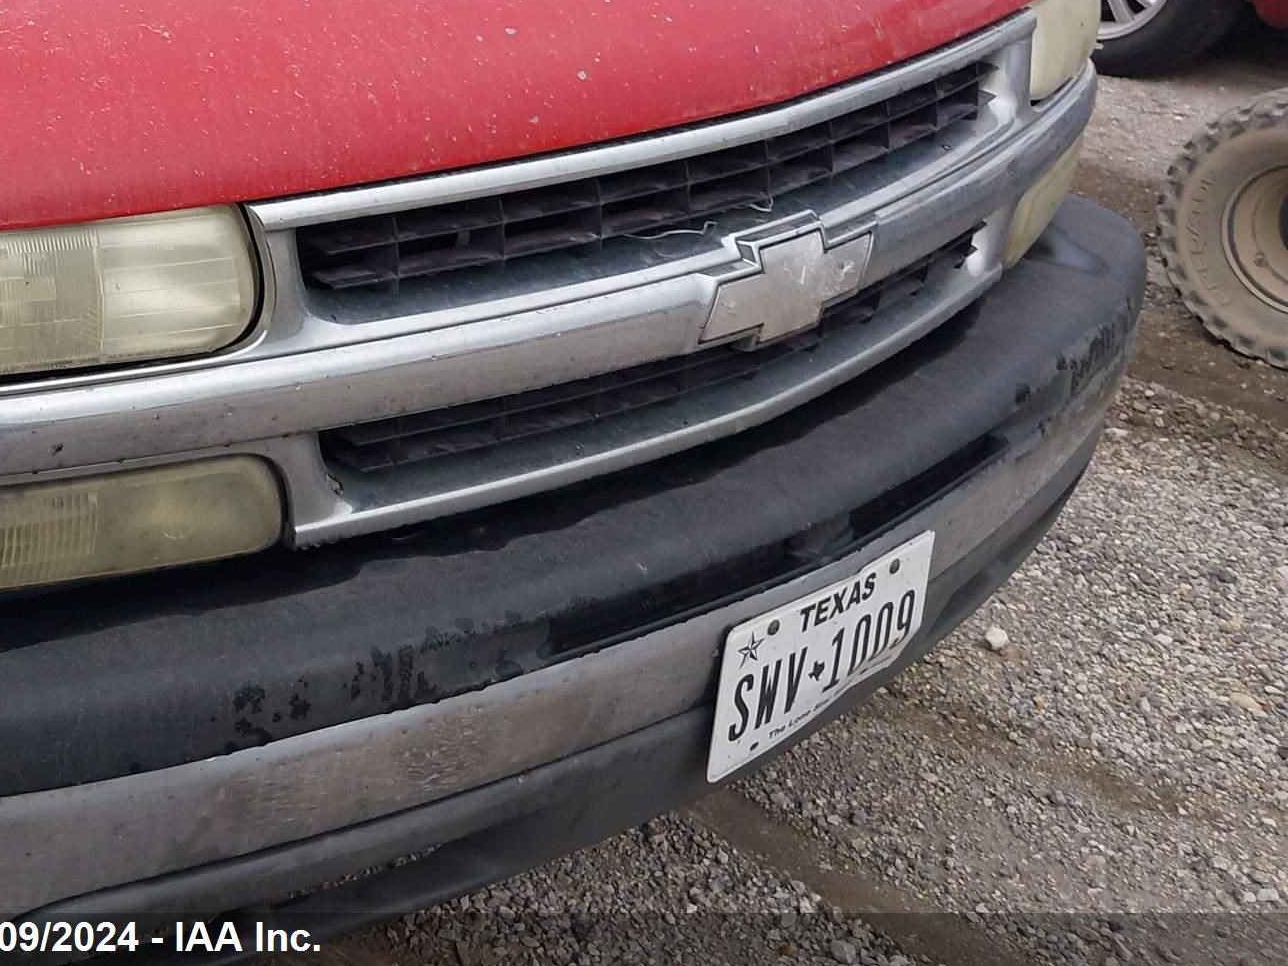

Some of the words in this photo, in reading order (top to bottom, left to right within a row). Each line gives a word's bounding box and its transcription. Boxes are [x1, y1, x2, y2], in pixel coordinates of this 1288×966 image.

[800, 572, 877, 633] TEXAS
[727, 646, 809, 742] SWV
[821, 589, 916, 694] 1009
[769, 725, 786, 739] The
